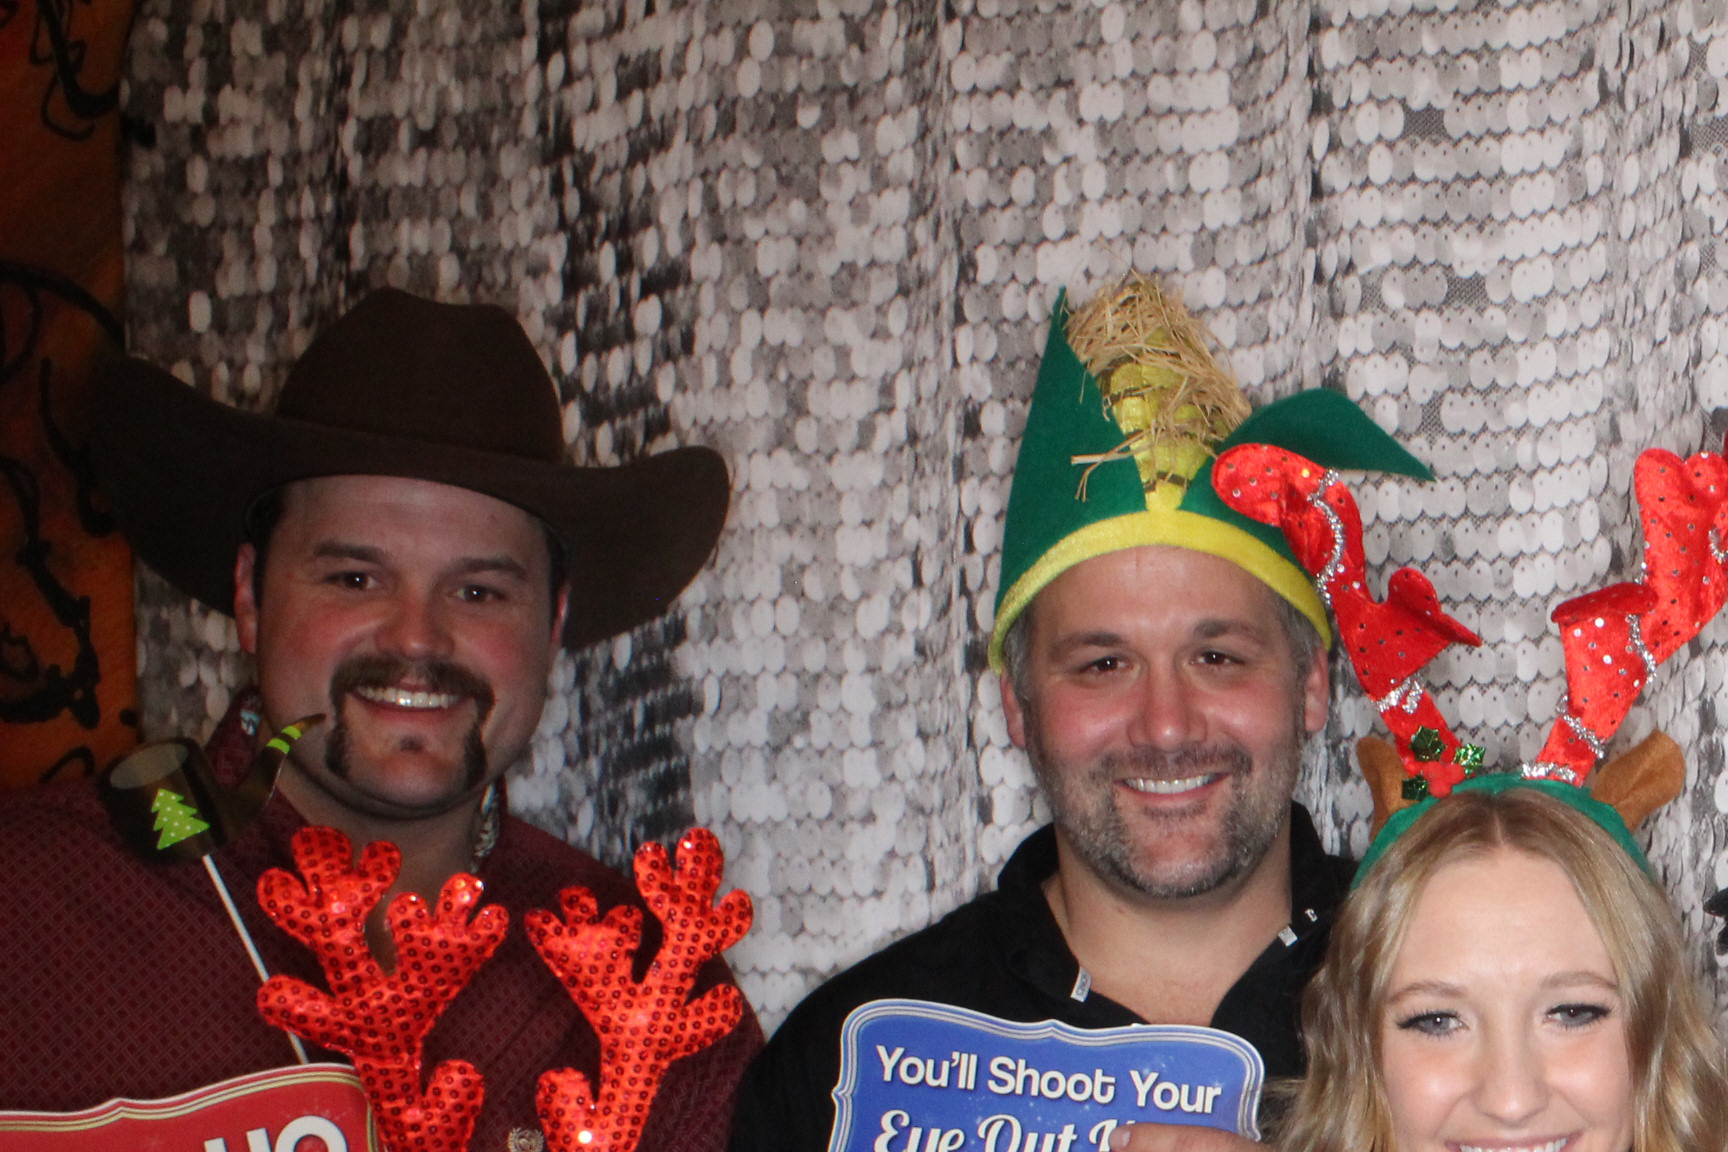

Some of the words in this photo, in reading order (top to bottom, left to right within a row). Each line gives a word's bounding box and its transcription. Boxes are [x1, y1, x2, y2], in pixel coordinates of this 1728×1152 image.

[876, 1045, 977, 1090] You'll
[987, 1056, 1116, 1104] Shoot
[1129, 1069, 1222, 1114] Your
